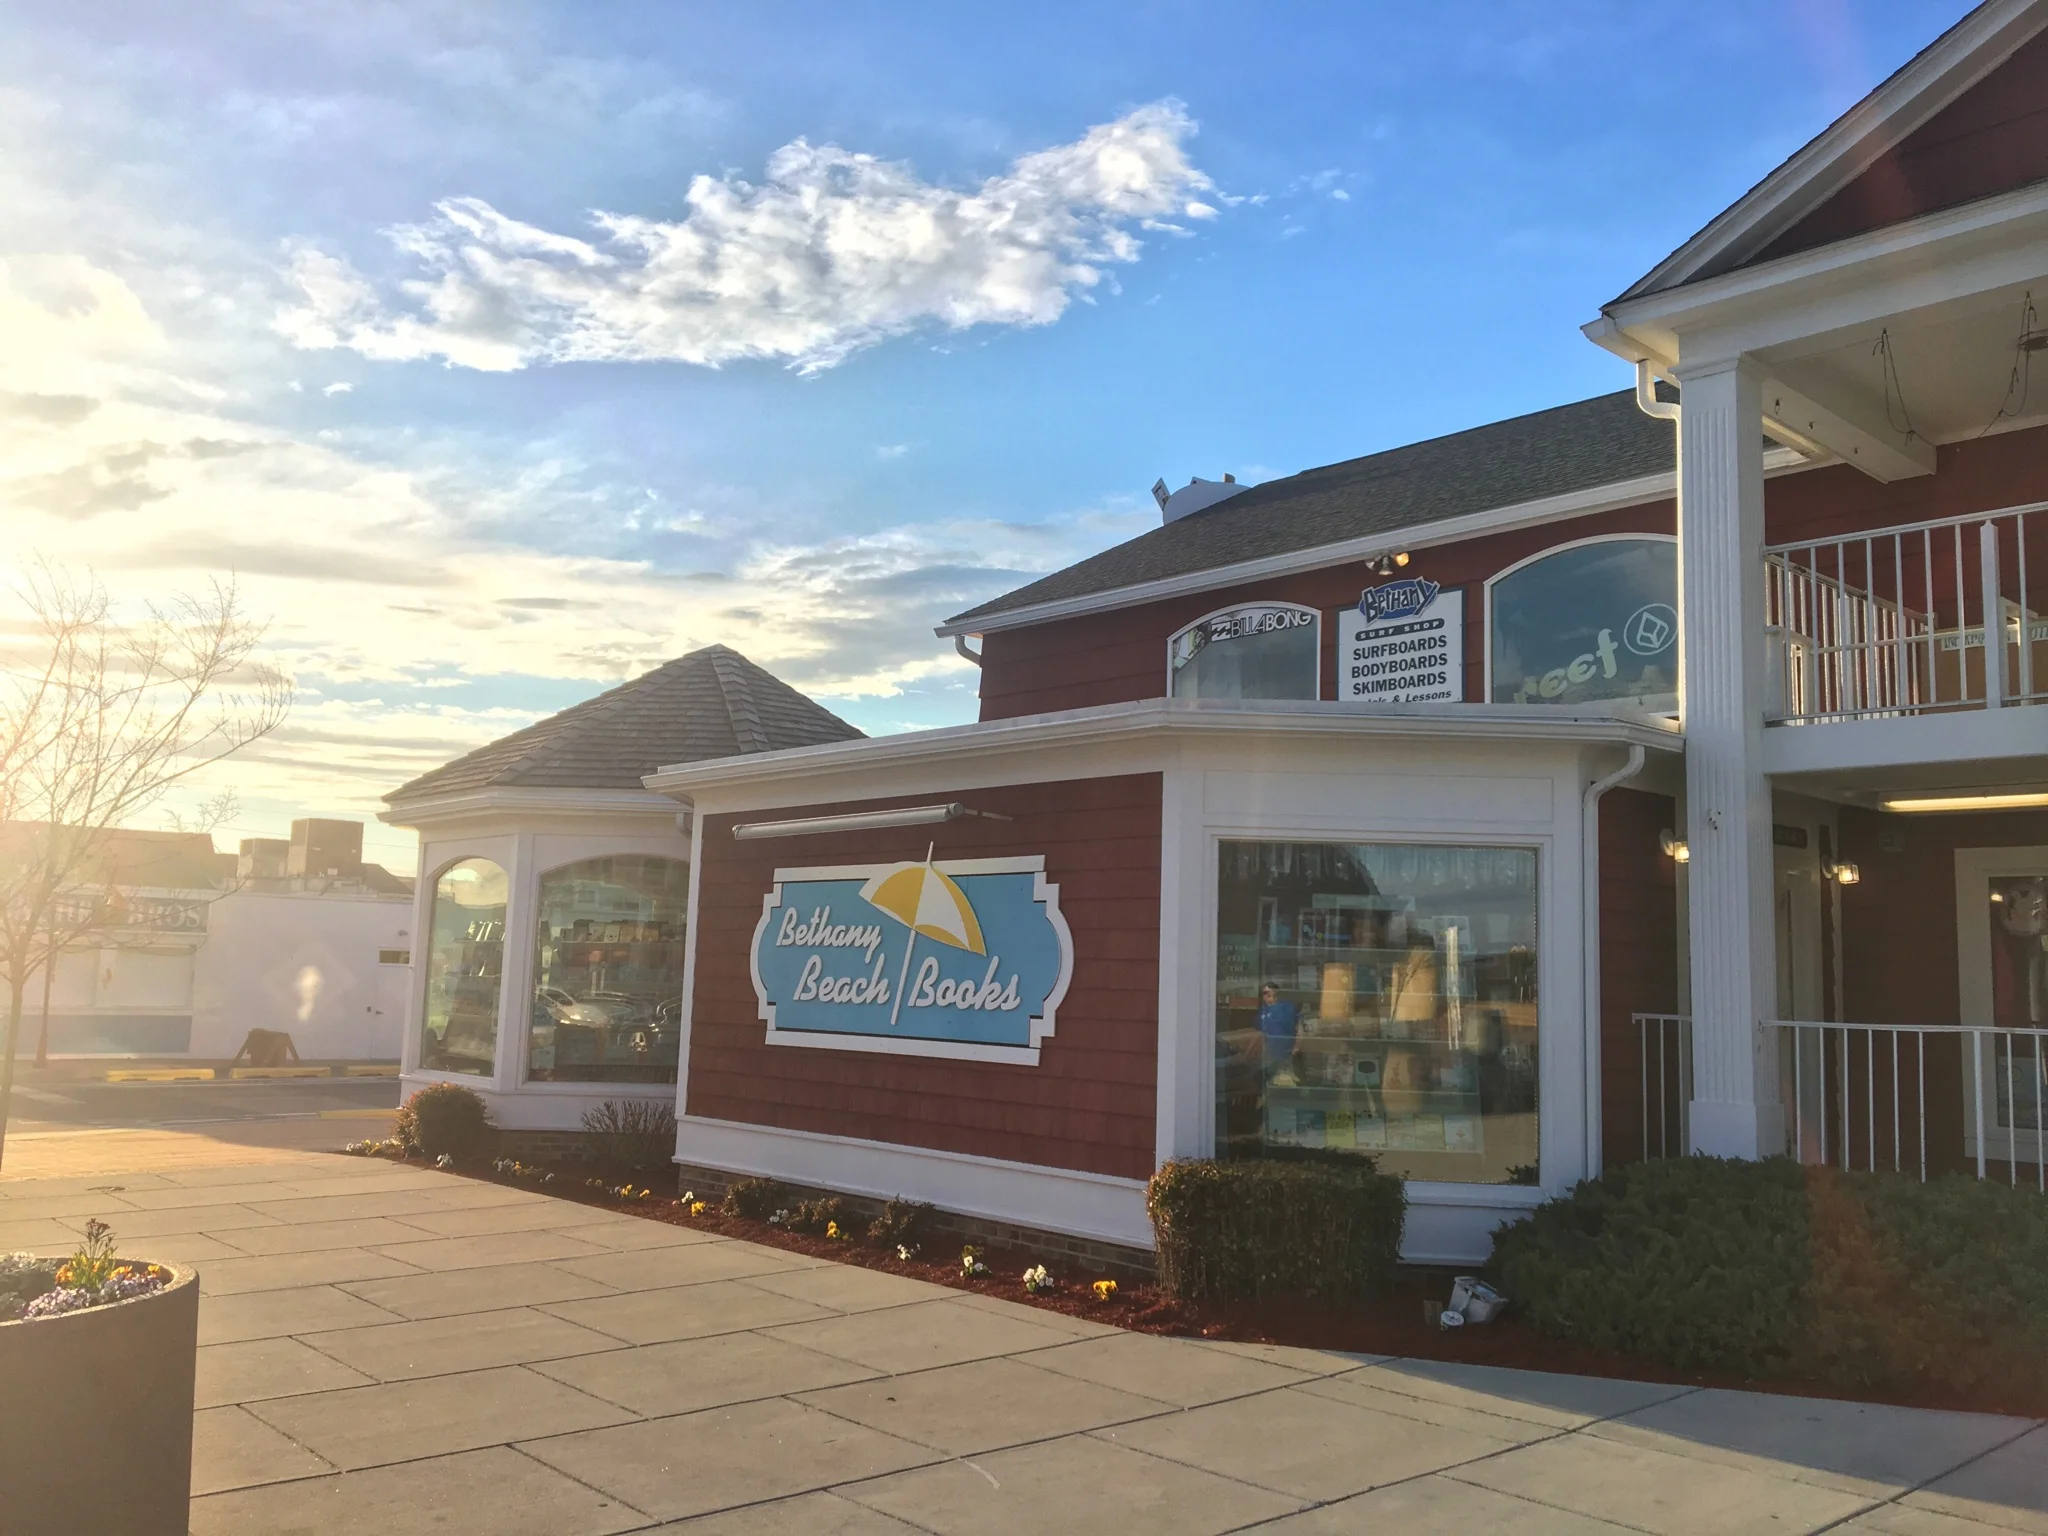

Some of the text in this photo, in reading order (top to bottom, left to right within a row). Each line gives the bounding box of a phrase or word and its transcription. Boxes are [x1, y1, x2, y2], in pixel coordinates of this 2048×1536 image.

[1231, 611, 1311, 638] BILLABONG
[1360, 620, 1440, 640] SURF SHOP
[1353, 634, 1448, 661] SURFBOARDS
[1351, 652, 1448, 679] BODYBOARDS
[1514, 628, 1619, 704] reef
[1352, 671, 1447, 695] SKIMBOARDS
[1405, 690, 1452, 703] Lessons
[776, 905, 882, 964] Bethany
[793, 953, 1021, 1011] Beach Books
